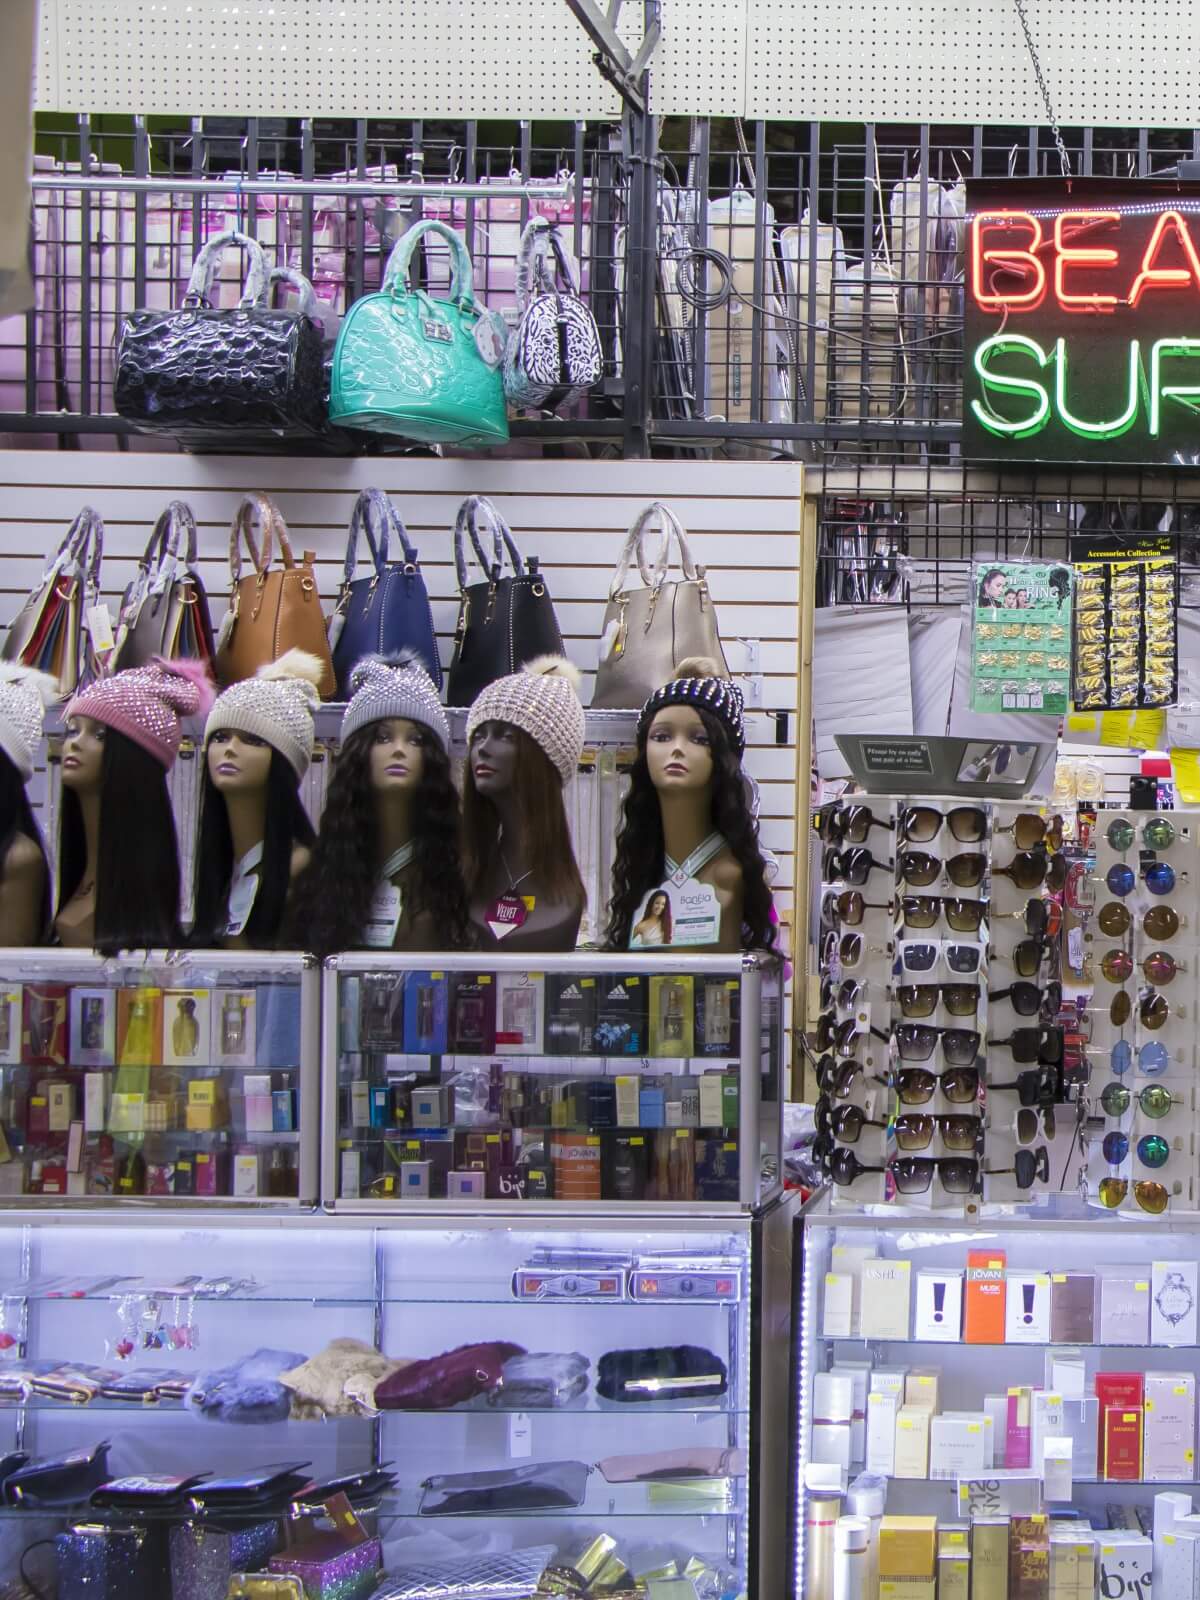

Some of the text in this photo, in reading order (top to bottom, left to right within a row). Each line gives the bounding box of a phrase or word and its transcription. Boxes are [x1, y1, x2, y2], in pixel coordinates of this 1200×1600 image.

[1087, 550, 1126, 558] Accessories
[1026, 586, 1060, 599] RING
[496, 903, 519, 918] VELVET
[972, 1271, 1001, 1279] JOVAN
